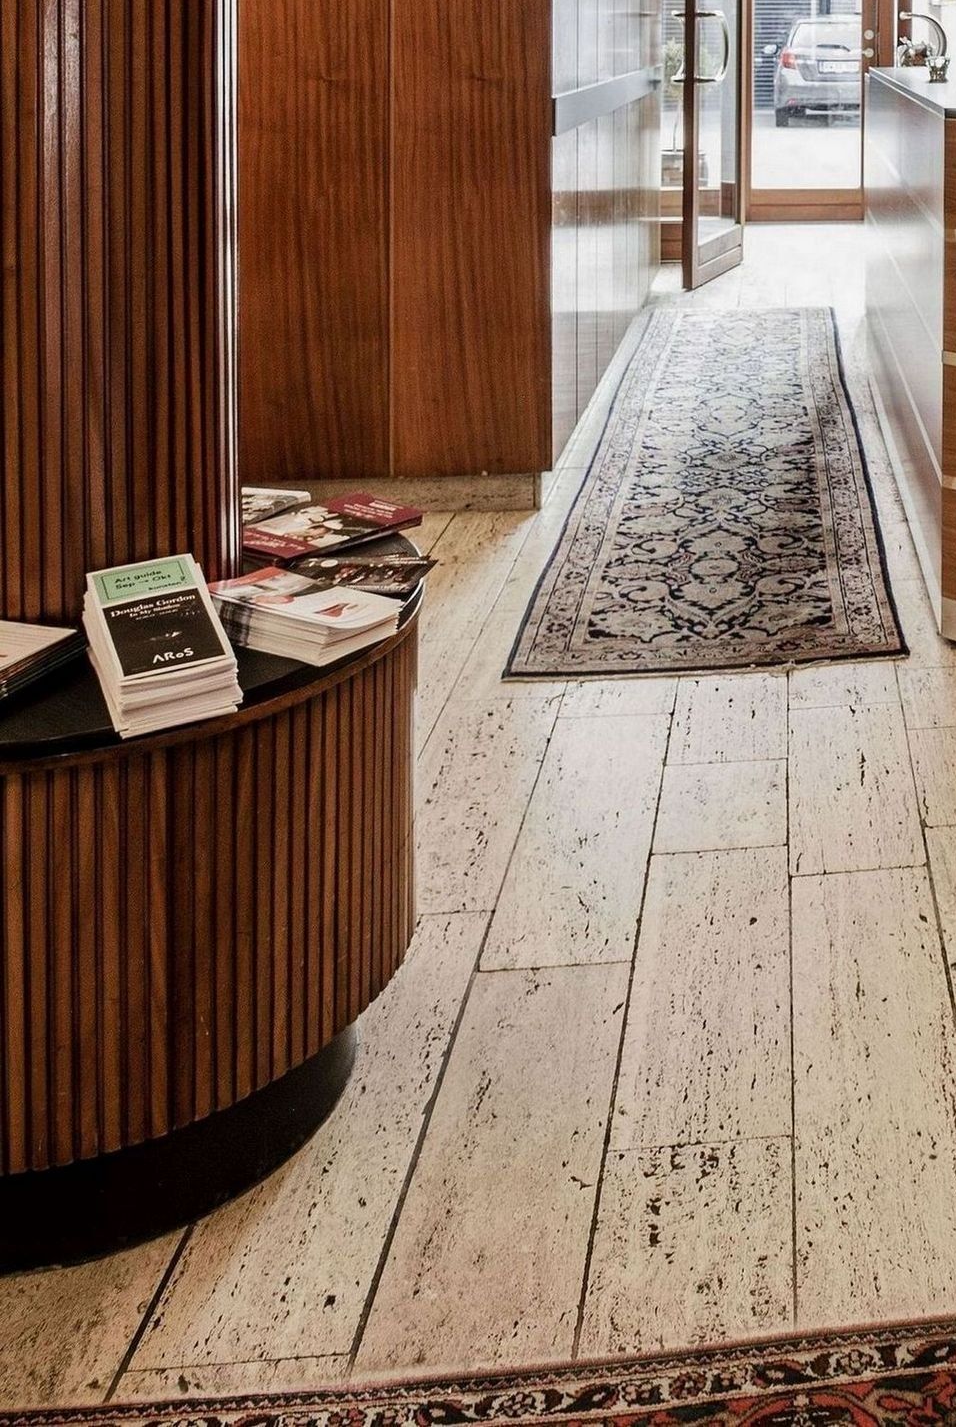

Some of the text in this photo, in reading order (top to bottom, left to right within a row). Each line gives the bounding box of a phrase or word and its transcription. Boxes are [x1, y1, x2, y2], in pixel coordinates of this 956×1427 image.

[114, 576, 131, 584] Art
[152, 574, 171, 582] Okt
[110, 603, 154, 618] Douglas
[156, 594, 196, 607] Gordon
[152, 647, 194, 664] ARoS
